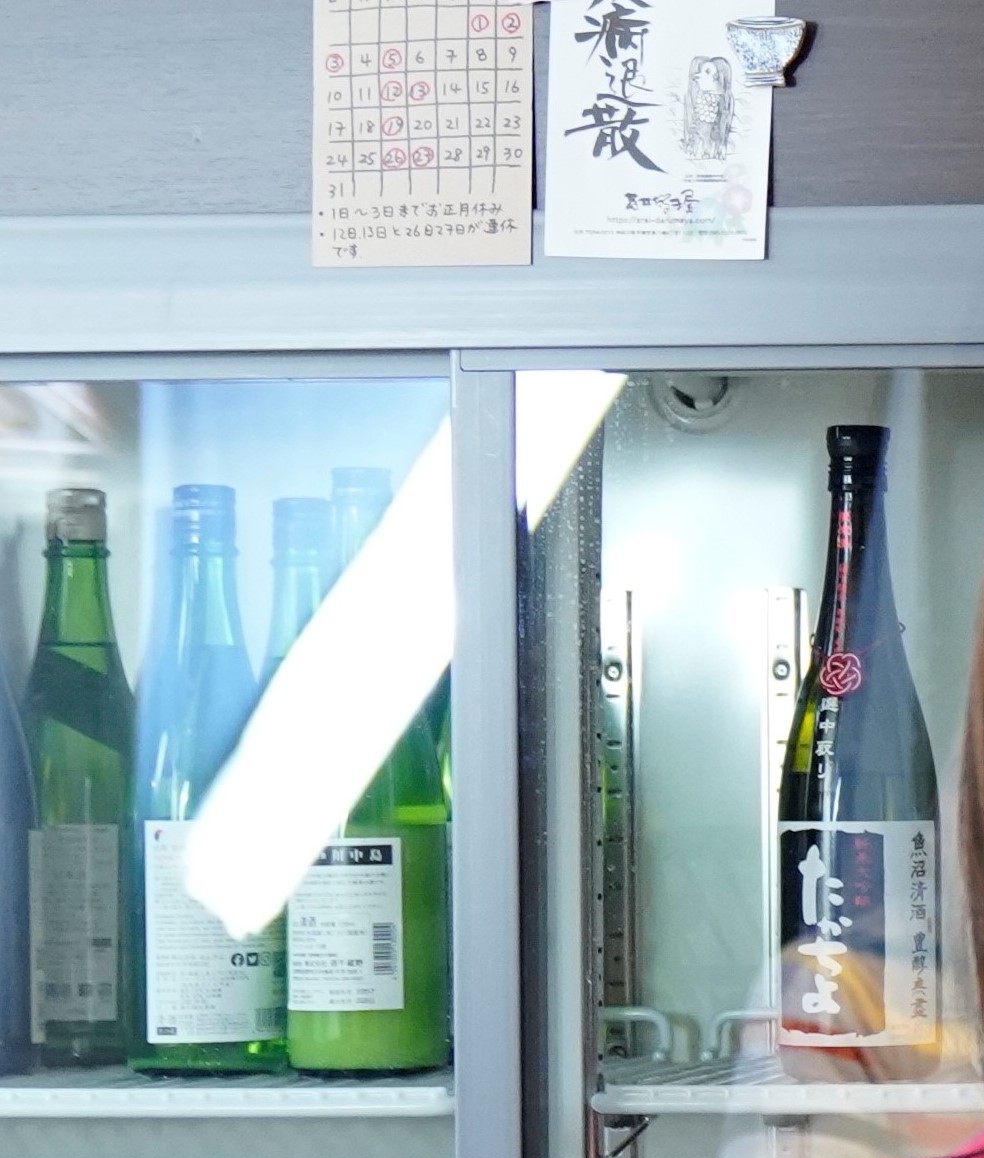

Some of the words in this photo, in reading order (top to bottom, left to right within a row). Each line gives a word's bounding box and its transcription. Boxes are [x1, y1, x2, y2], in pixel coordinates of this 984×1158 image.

[359, 54, 372, 67] 4
[415, 50, 425, 64] 6
[445, 49, 458, 62] 7
[475, 48, 488, 62] 8
[508, 46, 517, 63] 9
[327, 91, 343, 104] 10
[358, 87, 372, 100] 11
[442, 83, 463, 96] 14
[475, 81, 491, 94] 15
[504, 80, 520, 94] 16
[565, 0, 669, 174] 病退散
[328, 123, 347, 137] 17
[359, 120, 375, 134] 18
[413, 120, 433, 131] 20
[445, 117, 459, 131] 21
[474, 117, 492, 129] 22
[503, 115, 522, 129] 23
[325, 153, 348, 166] 24
[357, 151, 377, 166] 25
[443, 148, 463, 162] 28
[475, 145, 491, 160] 29
[502, 146, 523, 160] 30
[328, 184, 344, 198] 31
[909, 830, 928, 921] 魚沼清酒
[798, 844, 853, 1015] たかちよ
